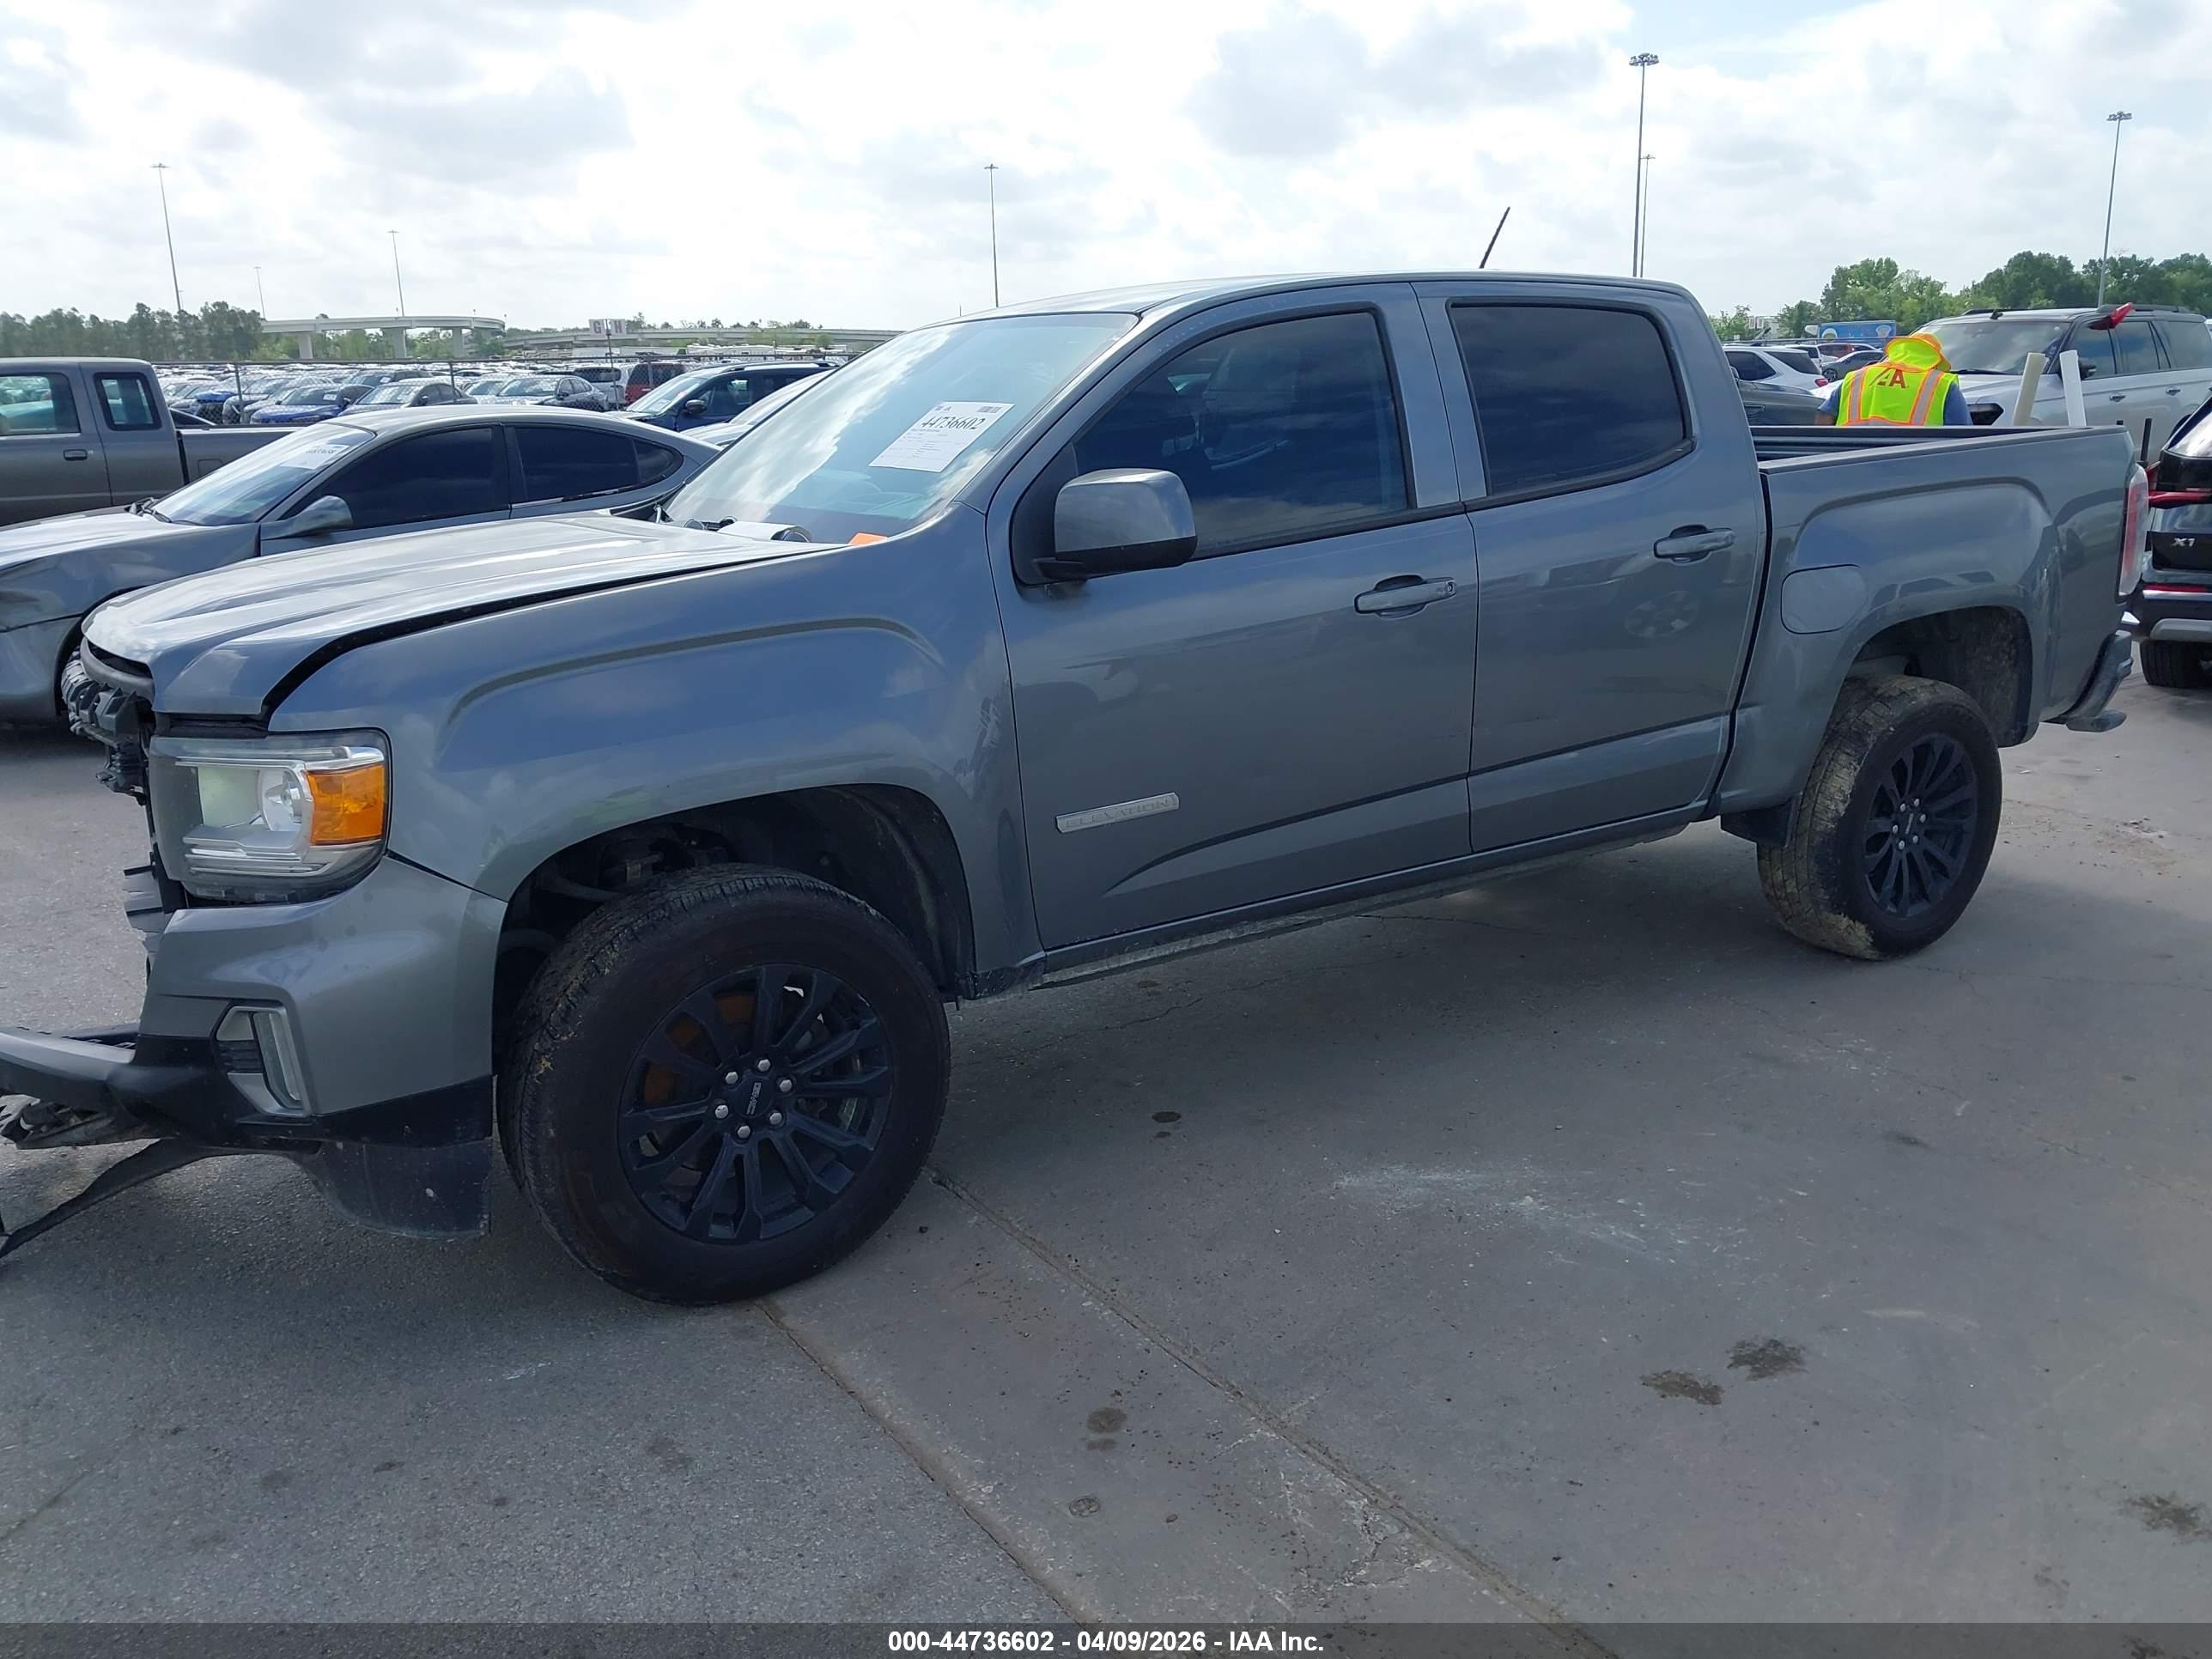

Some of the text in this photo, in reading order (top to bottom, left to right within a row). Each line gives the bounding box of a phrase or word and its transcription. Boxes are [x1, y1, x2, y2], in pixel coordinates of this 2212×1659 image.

[592, 320, 602, 333] G
[921, 416, 987, 430] 44736602
[2171, 537, 2196, 548] X1
